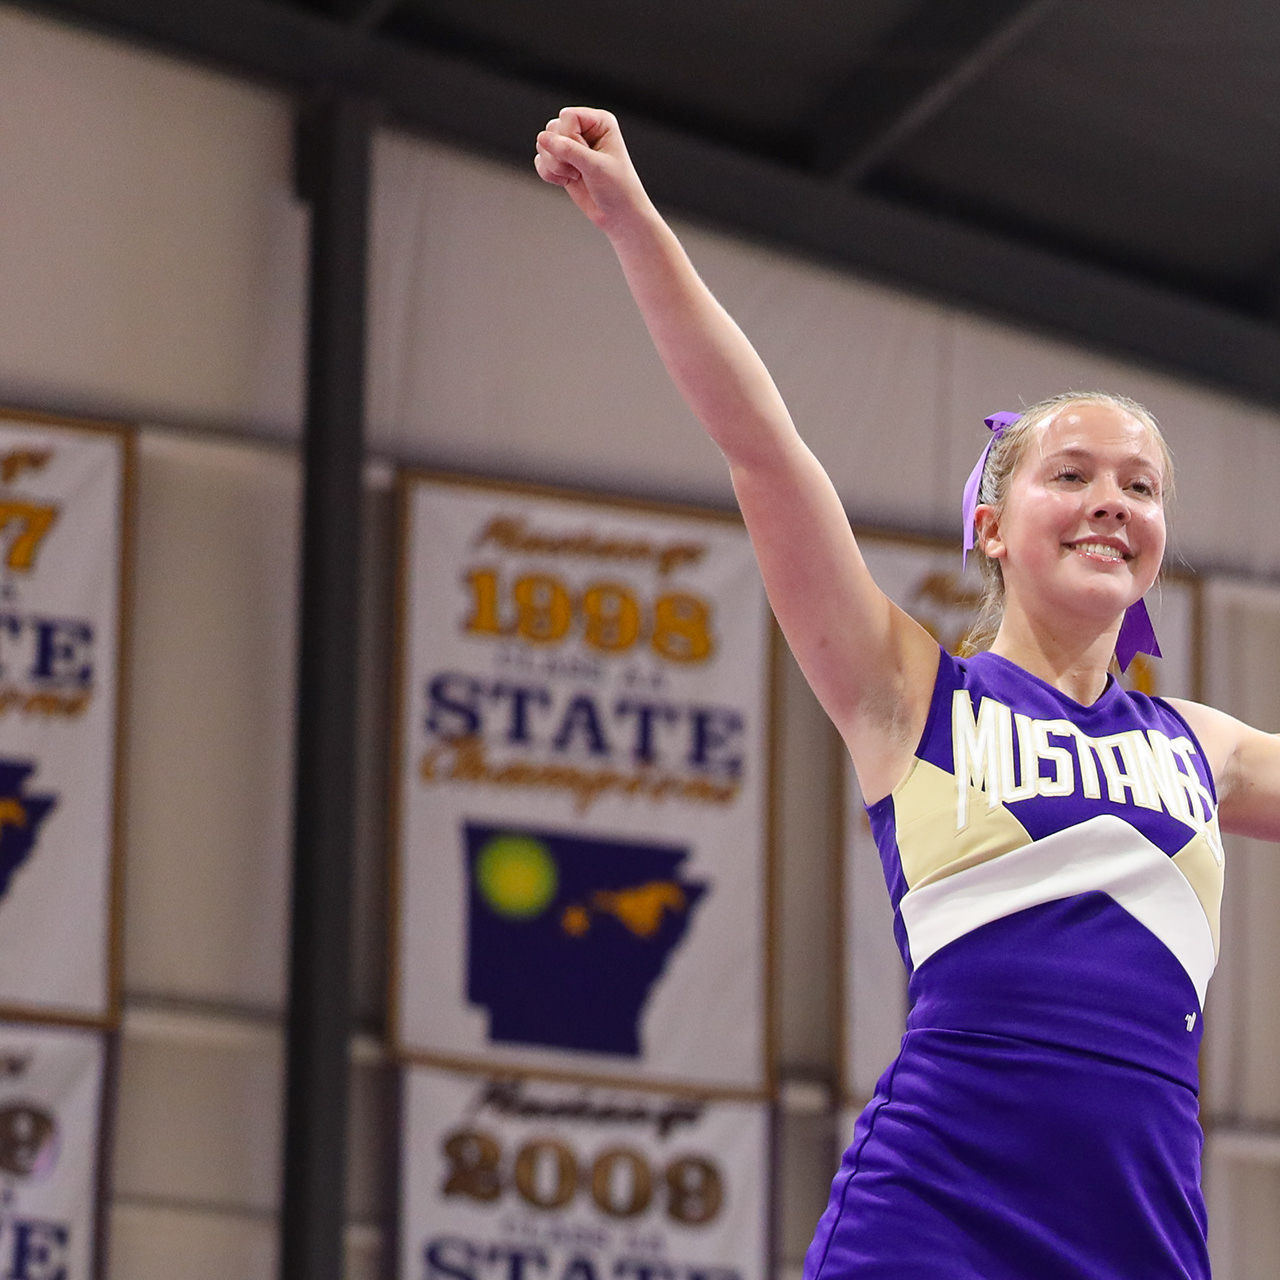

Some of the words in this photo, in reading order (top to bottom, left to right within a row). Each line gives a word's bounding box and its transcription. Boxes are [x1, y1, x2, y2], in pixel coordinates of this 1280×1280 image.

[463, 567, 716, 667] 1998
[423, 670, 745, 780] STATE
[441, 1127, 725, 1228] 2009
